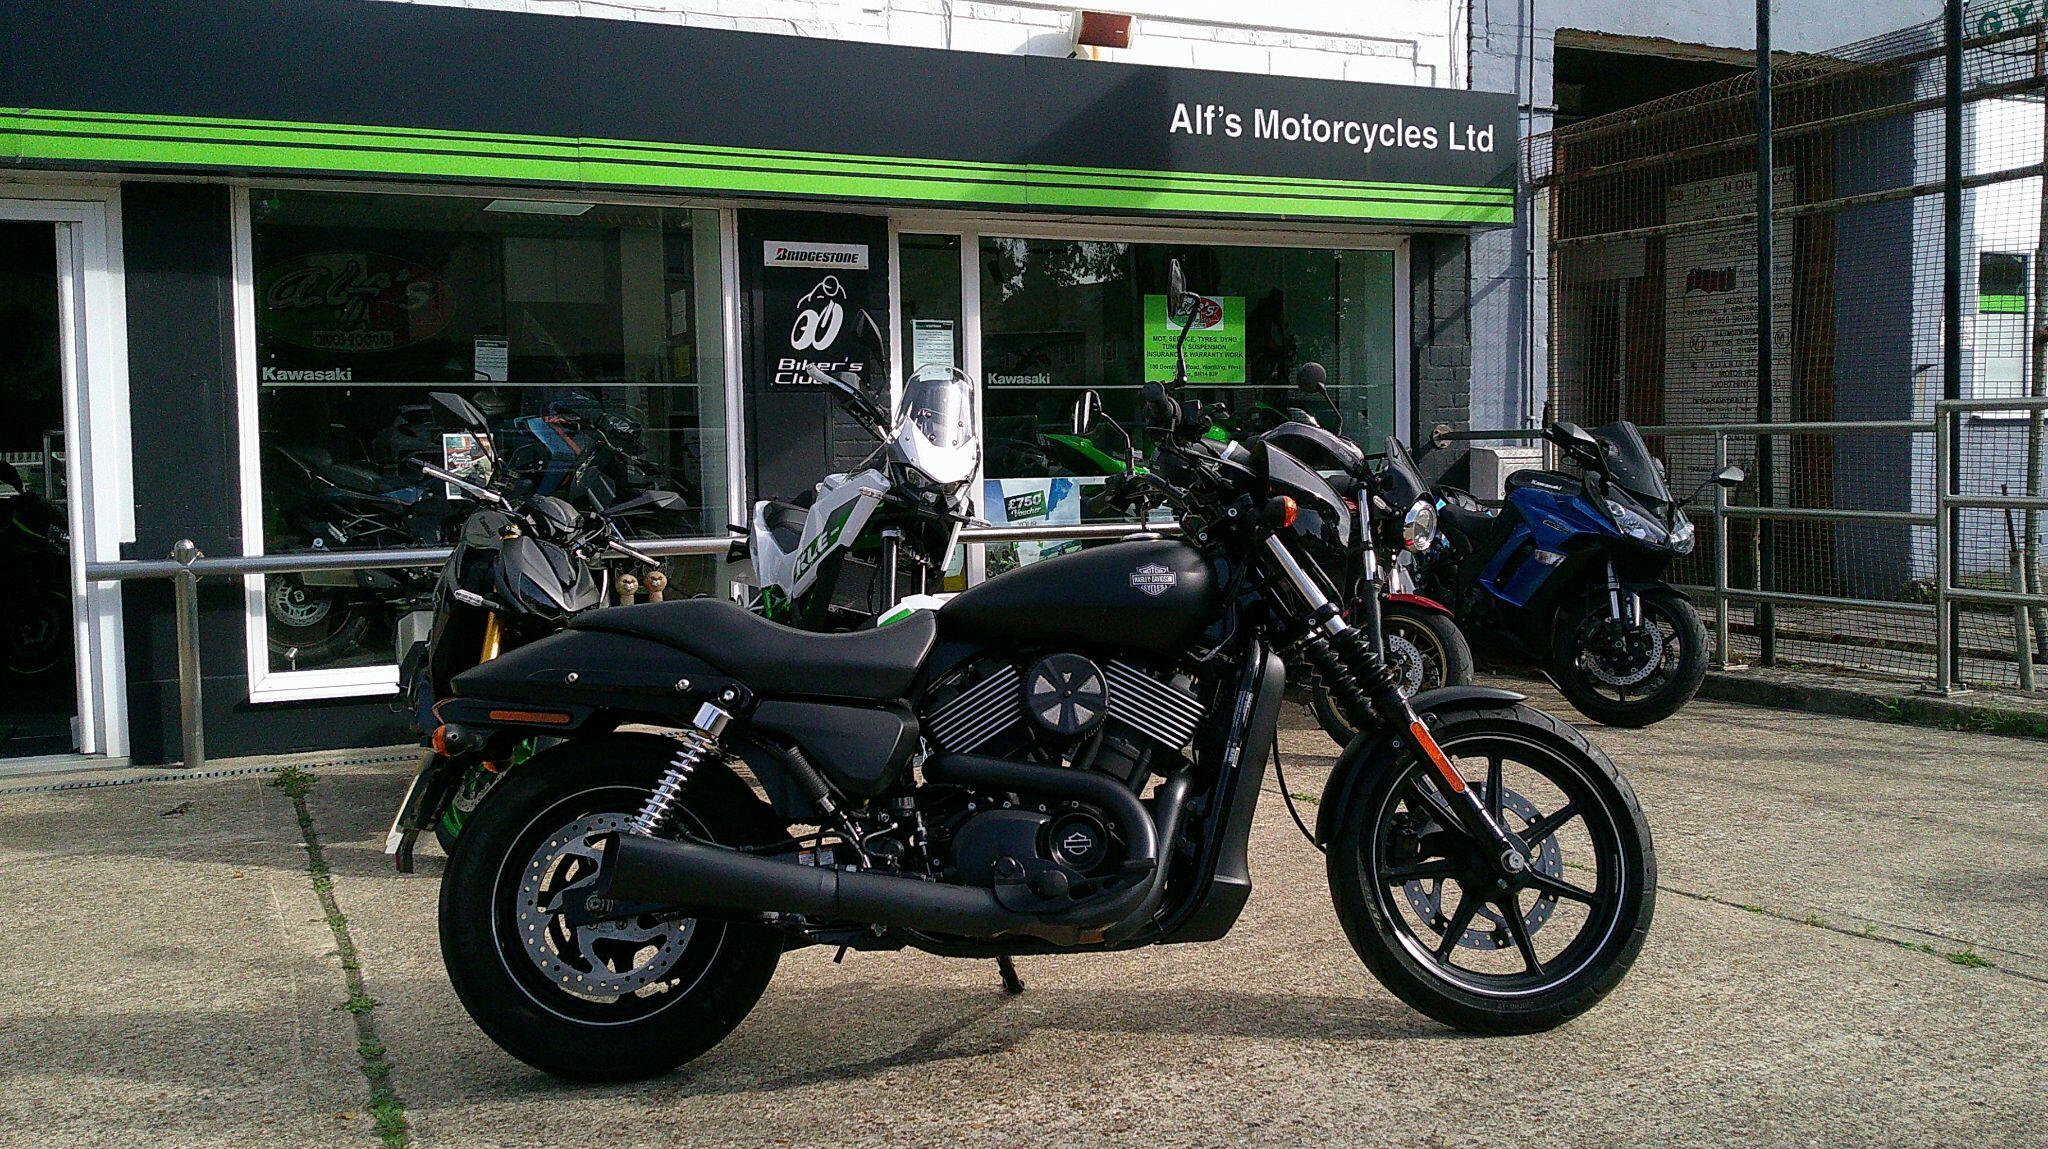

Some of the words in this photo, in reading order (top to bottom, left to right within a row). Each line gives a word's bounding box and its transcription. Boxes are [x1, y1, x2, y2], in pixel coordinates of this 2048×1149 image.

[1169, 102, 1242, 138] Alf's
[1254, 108, 1439, 153] Motorcycles
[1449, 121, 1494, 152] Ltd
[775, 247, 859, 264] BRIDGESTONE
[1152, 335, 1166, 344] MOT,
[1168, 336, 1197, 344] SEICE,
[1197, 336, 1219, 344] TYRES,
[1224, 351, 1244, 359] WORK
[777, 357, 863, 371] Biker's
[262, 366, 352, 381] Kawasaki
[774, 372, 831, 385] Clu
[988, 372, 1051, 385] Kawasaki
[1007, 493, 1042, 511] £750
[1010, 507, 1042, 518] Voucher
[796, 530, 829, 577] KLE
